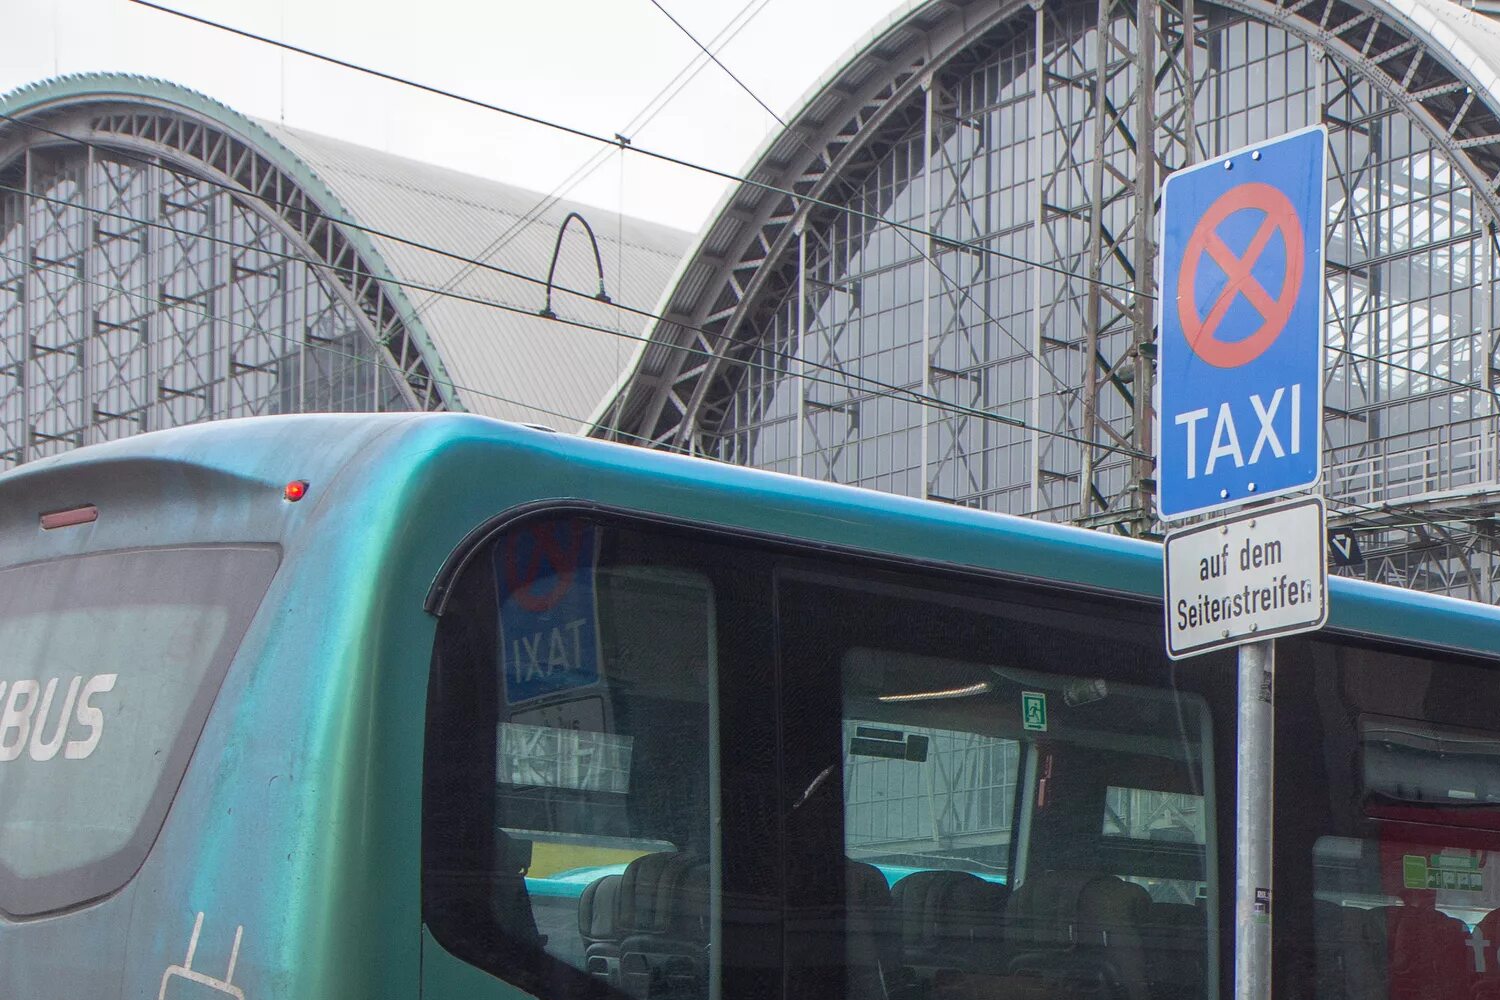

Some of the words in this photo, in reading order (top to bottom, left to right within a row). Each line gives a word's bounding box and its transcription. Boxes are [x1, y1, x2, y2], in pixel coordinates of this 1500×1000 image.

[1175, 384, 1300, 480] TAXI
[1199, 544, 1229, 581] auf
[1240, 538, 1282, 571] dem
